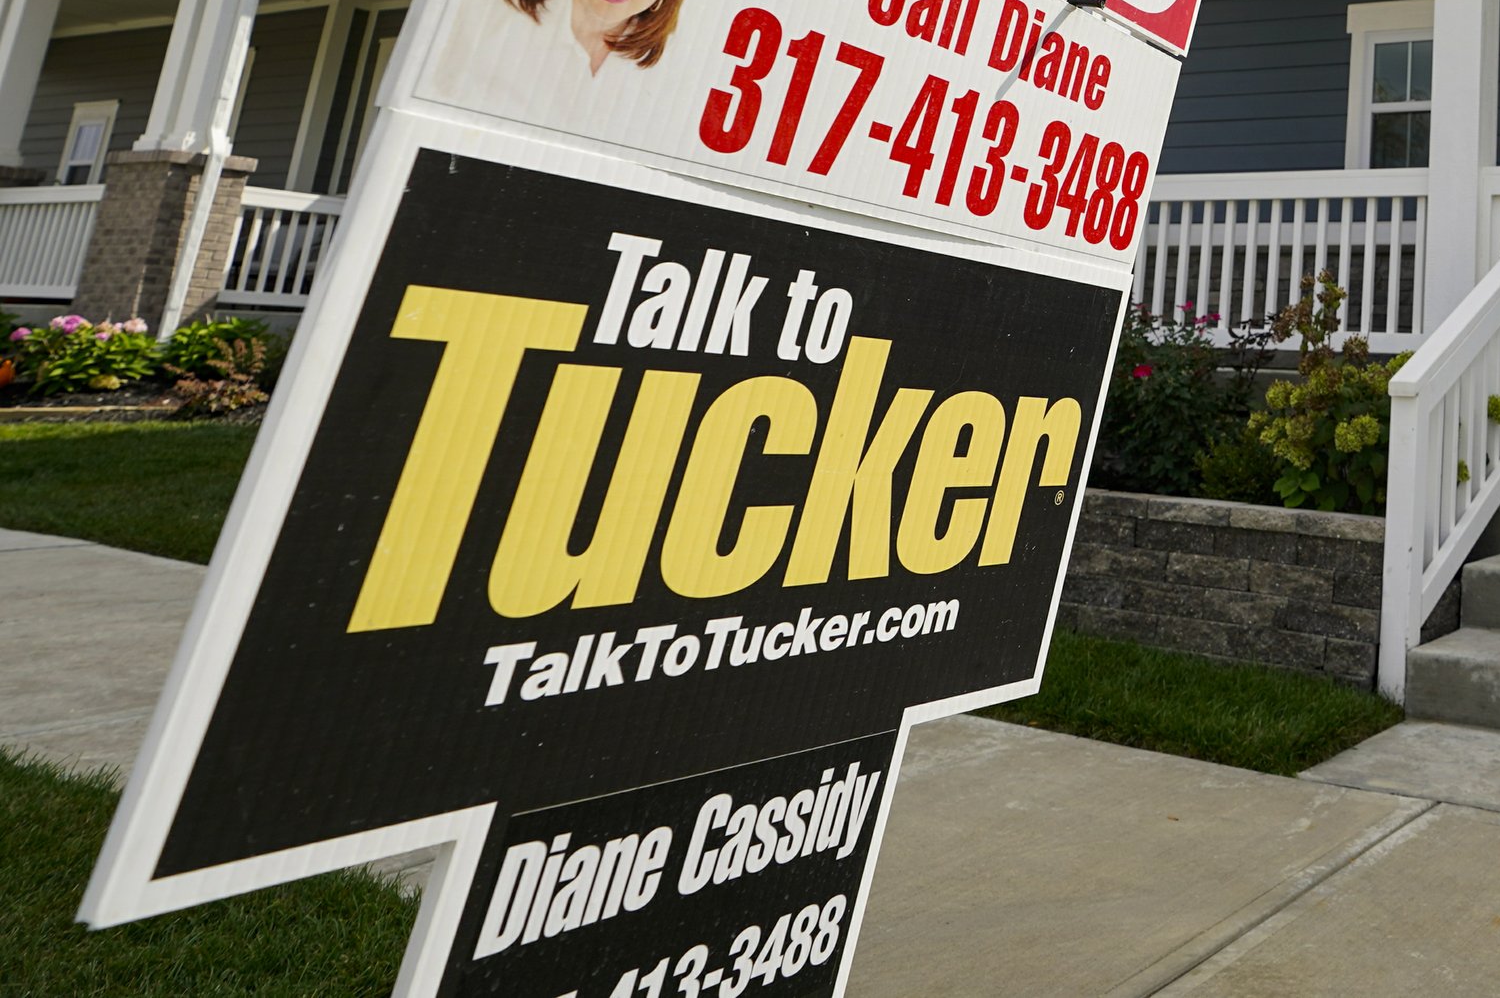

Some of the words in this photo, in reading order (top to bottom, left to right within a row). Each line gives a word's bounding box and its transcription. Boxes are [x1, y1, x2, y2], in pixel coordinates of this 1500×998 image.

[698, 7, 1149, 251] 317-413-3488
[593, 232, 769, 357] Talk
[776, 269, 853, 364] to
[483, 599, 960, 706] TalkToTucker.com
[472, 826, 673, 961] Diane
[677, 761, 881, 896] Cassidy
